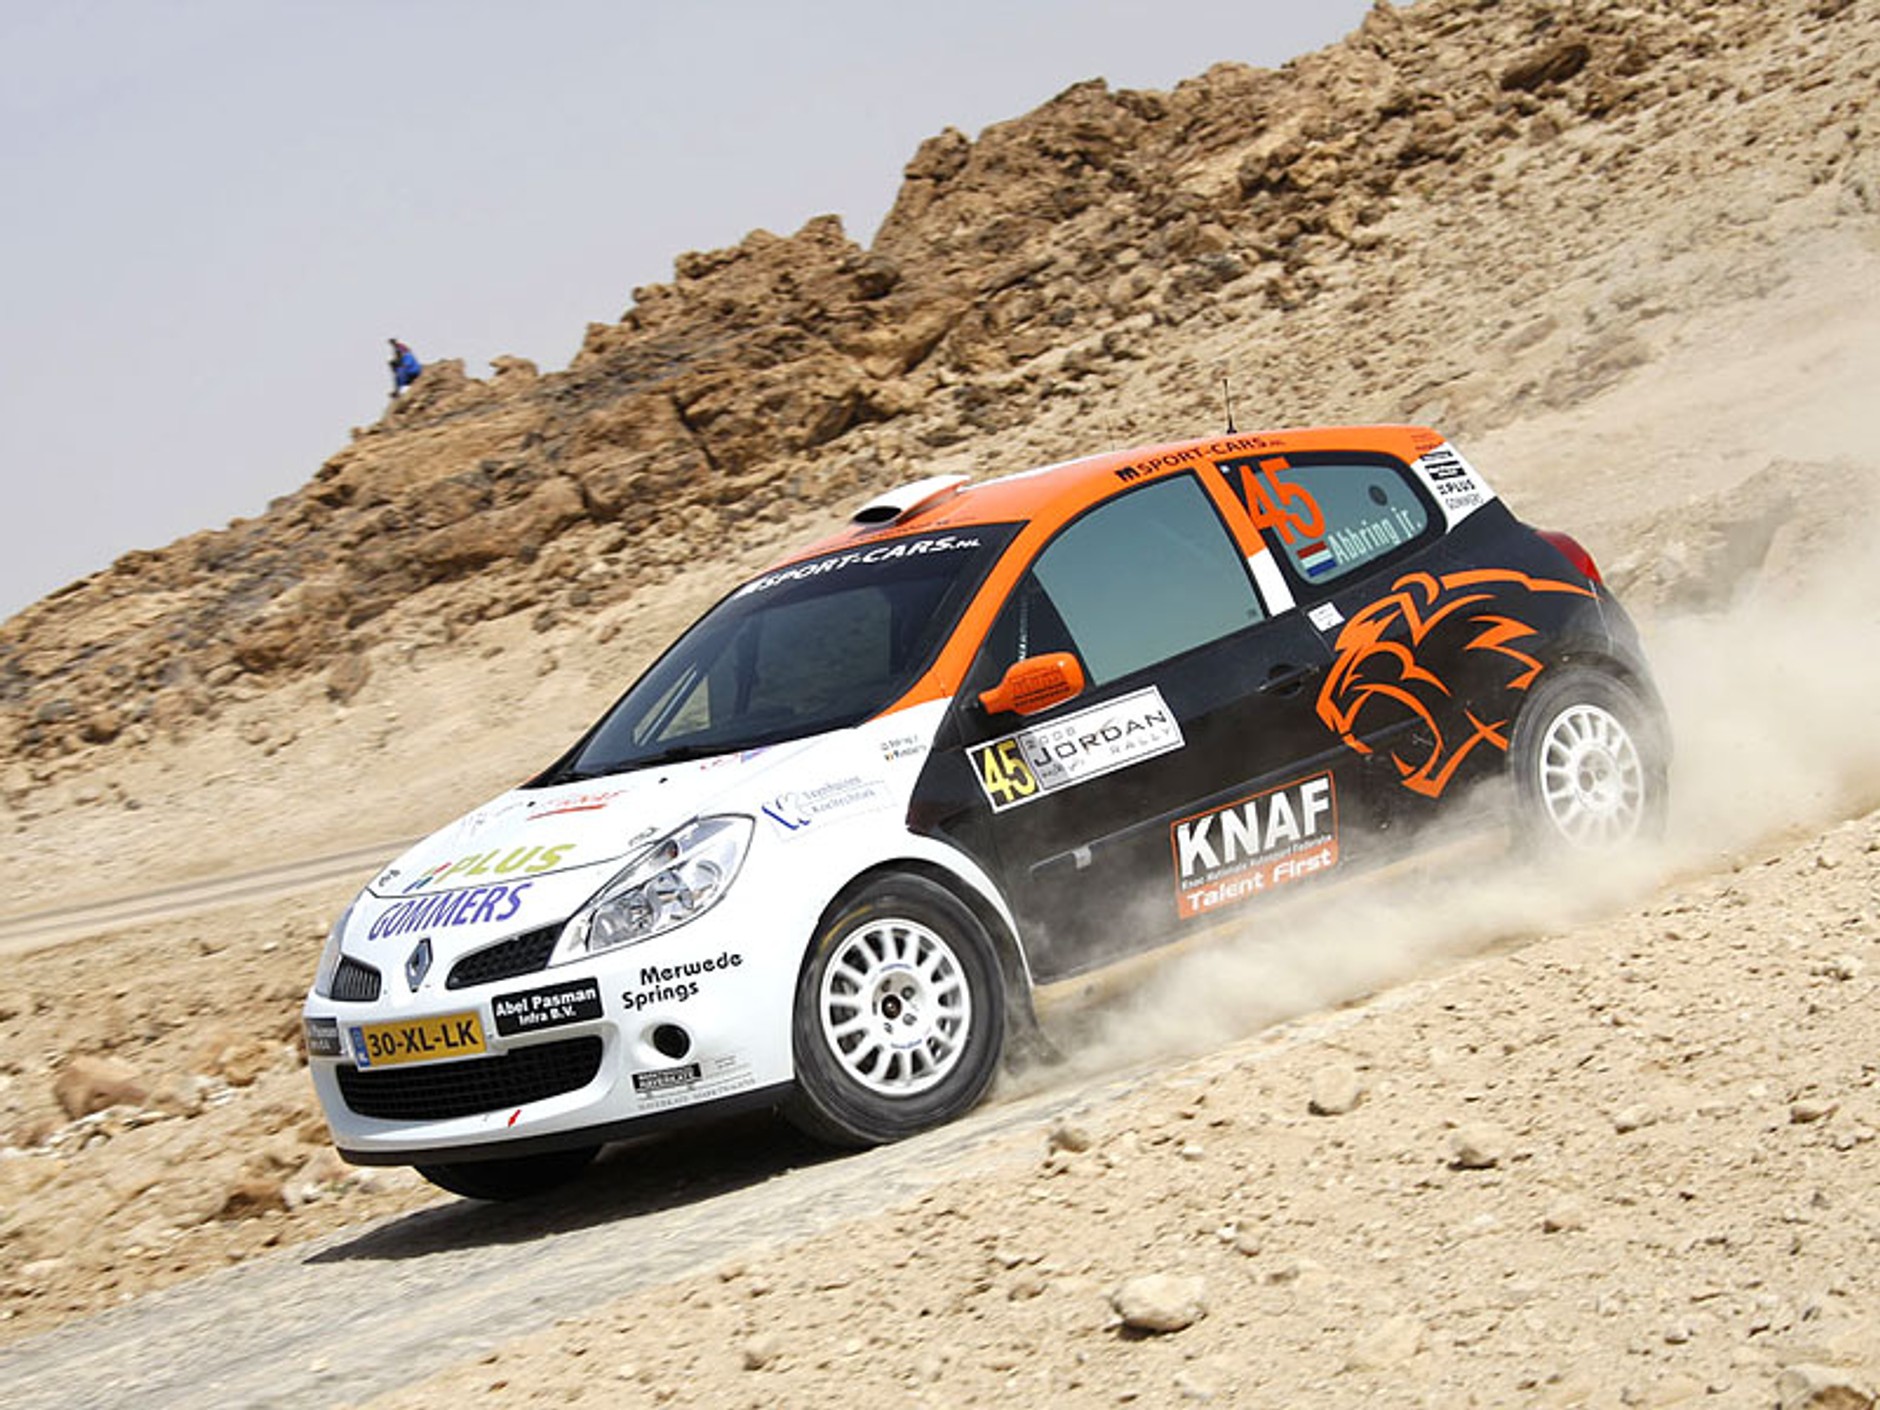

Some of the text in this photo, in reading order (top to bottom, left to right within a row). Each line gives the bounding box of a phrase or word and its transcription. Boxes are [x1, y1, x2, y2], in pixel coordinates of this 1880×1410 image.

[1239, 456, 1325, 545] 45
[1327, 517, 1402, 564] Abbring
[1034, 709, 1168, 767] JORDAN
[983, 740, 1036, 802] 45
[1177, 778, 1329, 877] KNAF
[434, 843, 577, 884] PLUS
[1187, 849, 1332, 911] Talent First
[368, 882, 534, 941] GOMMERS
[640, 952, 743, 986] Merwede
[496, 986, 597, 1017] Abel Pasman
[518, 1006, 577, 1025] Infra B.V.
[621, 981, 699, 1011] Springs
[368, 1020, 479, 1057] 30-XL-LK
